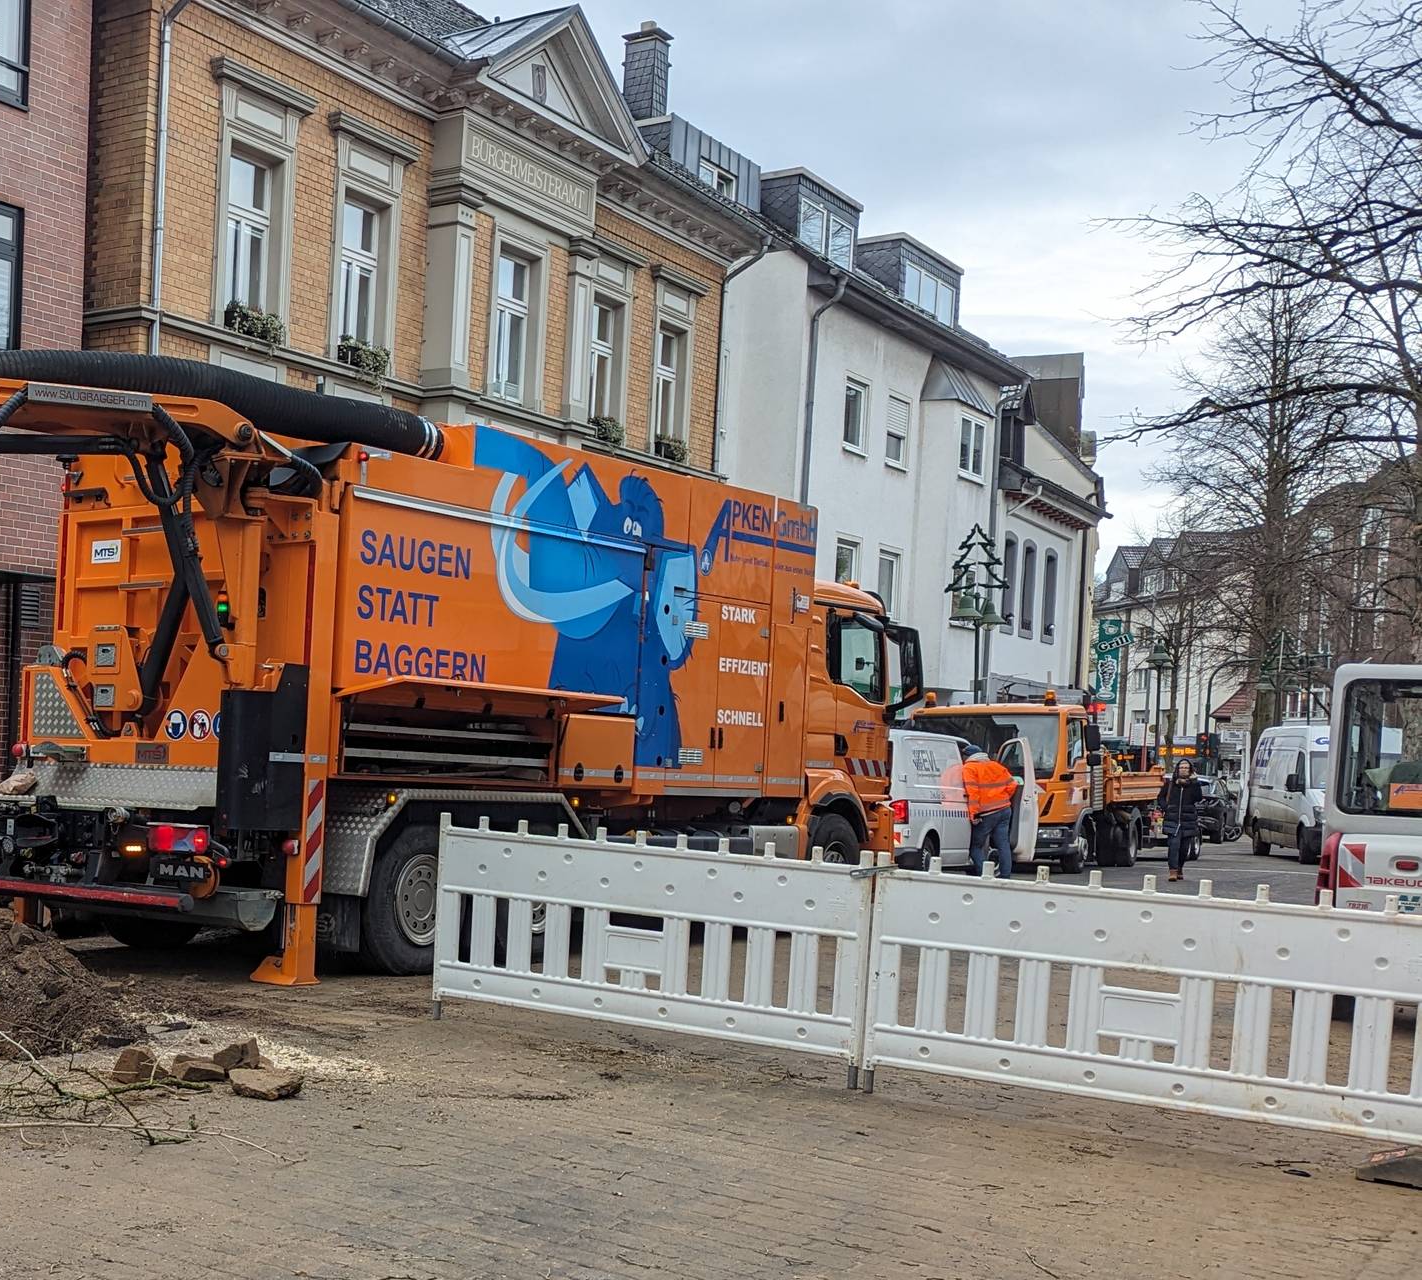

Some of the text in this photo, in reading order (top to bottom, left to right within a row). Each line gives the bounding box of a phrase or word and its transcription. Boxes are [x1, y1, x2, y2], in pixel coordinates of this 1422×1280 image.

[471, 135, 585, 209] BÜRGERMEISTERAMT
[700, 498, 817, 574] APKEN GmbH
[94, 547, 115, 558] MTS
[360, 529, 472, 580] SAUGEN
[356, 584, 439, 627] STATT
[721, 605, 756, 624] STARK
[1099, 634, 1131, 652] Grill
[354, 638, 486, 683] BAGGERN
[719, 656, 772, 677] EFFIZIENT
[717, 708, 764, 728] SCHNELL
[159, 863, 204, 879] MAN
